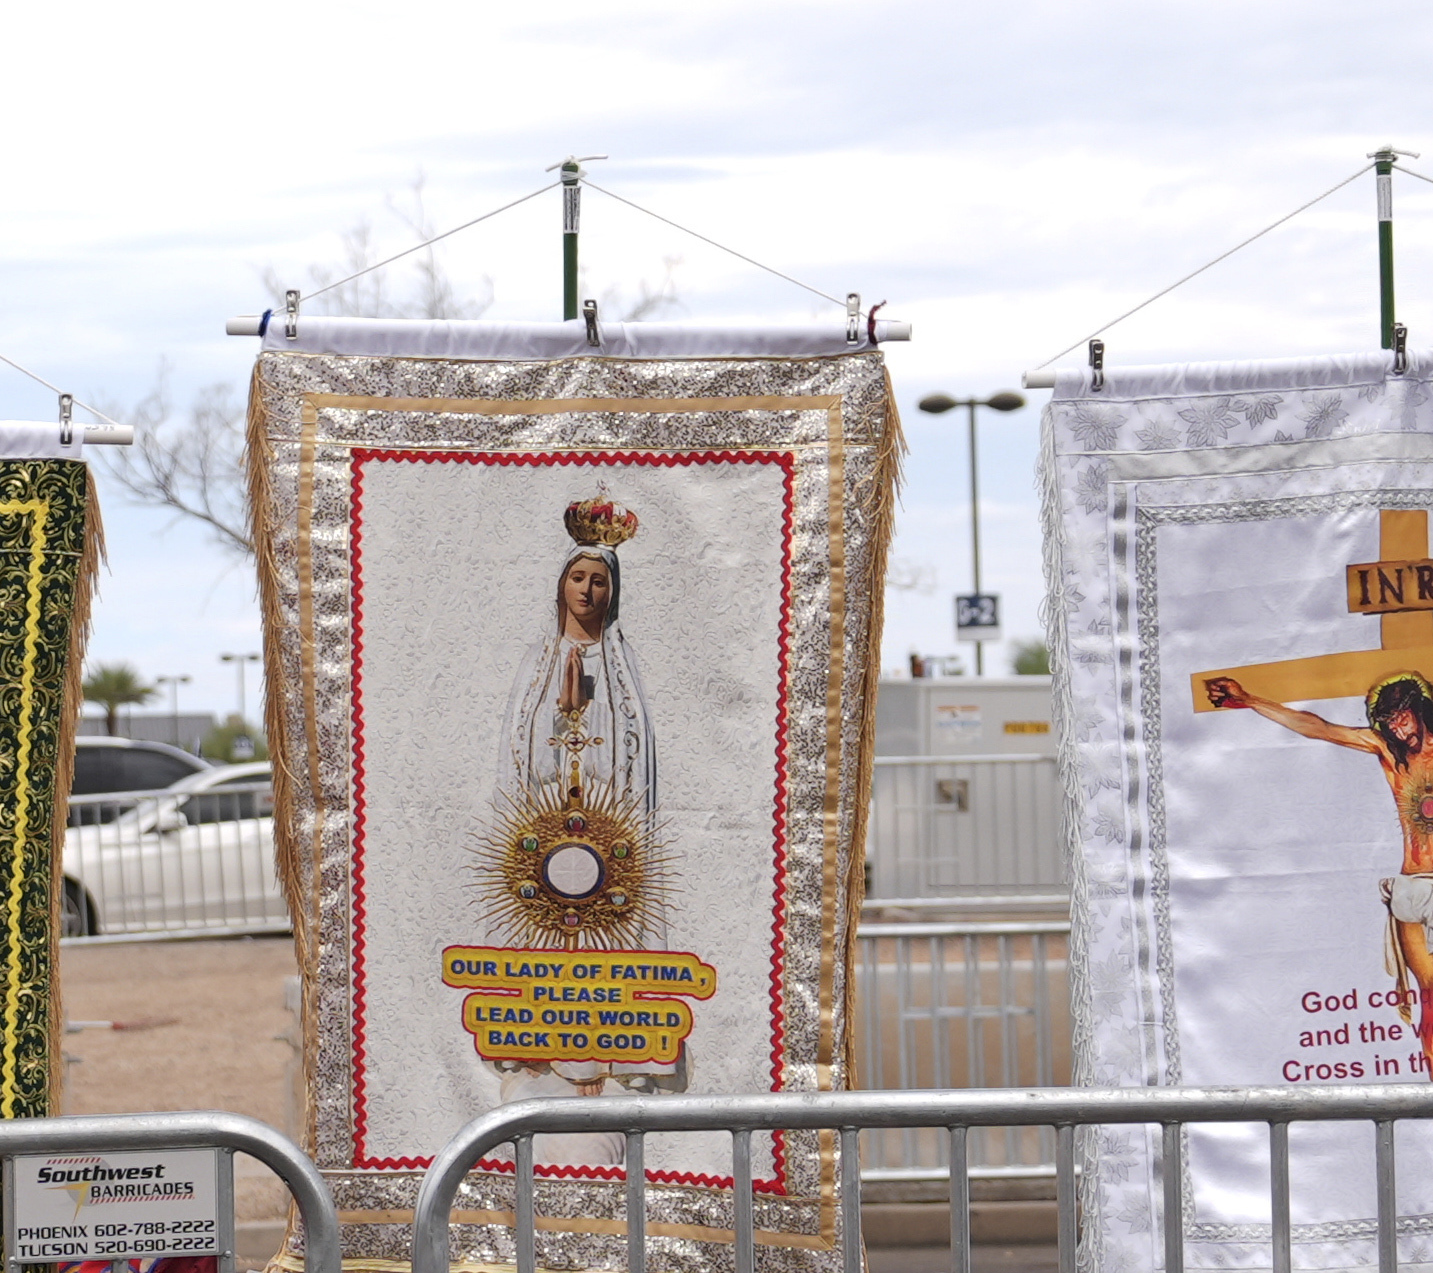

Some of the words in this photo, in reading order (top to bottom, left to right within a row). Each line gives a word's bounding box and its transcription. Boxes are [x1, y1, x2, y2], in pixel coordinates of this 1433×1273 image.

[451, 959, 497, 976] OUR
[505, 962, 563, 978] LADY
[572, 964, 602, 979] OF
[611, 964, 693, 982] FATIMA
[533, 986, 622, 1003] PLEASE
[1301, 988, 1357, 1013] God
[475, 1006, 533, 1023] LEAD
[541, 1008, 591, 1026] OUR
[599, 1010, 680, 1028] WORLD
[488, 1030, 550, 1047] BACK
[558, 1032, 587, 1048] TO
[597, 1033, 646, 1050] GOD
[1299, 1023, 1349, 1047] and
[1359, 1021, 1402, 1043] the
[1282, 1059, 1364, 1082] Cross
[1375, 1055, 1400, 1076] in
[37, 1164, 165, 1183] Southwest
[91, 1181, 194, 1198] BARRICADES
[18, 1225, 88, 1240] PHOENIX
[94, 1220, 215, 1238] 602-788-2222
[19, 1242, 88, 1257] TUCSON
[94, 1237, 215, 1254] 520-690-2222
